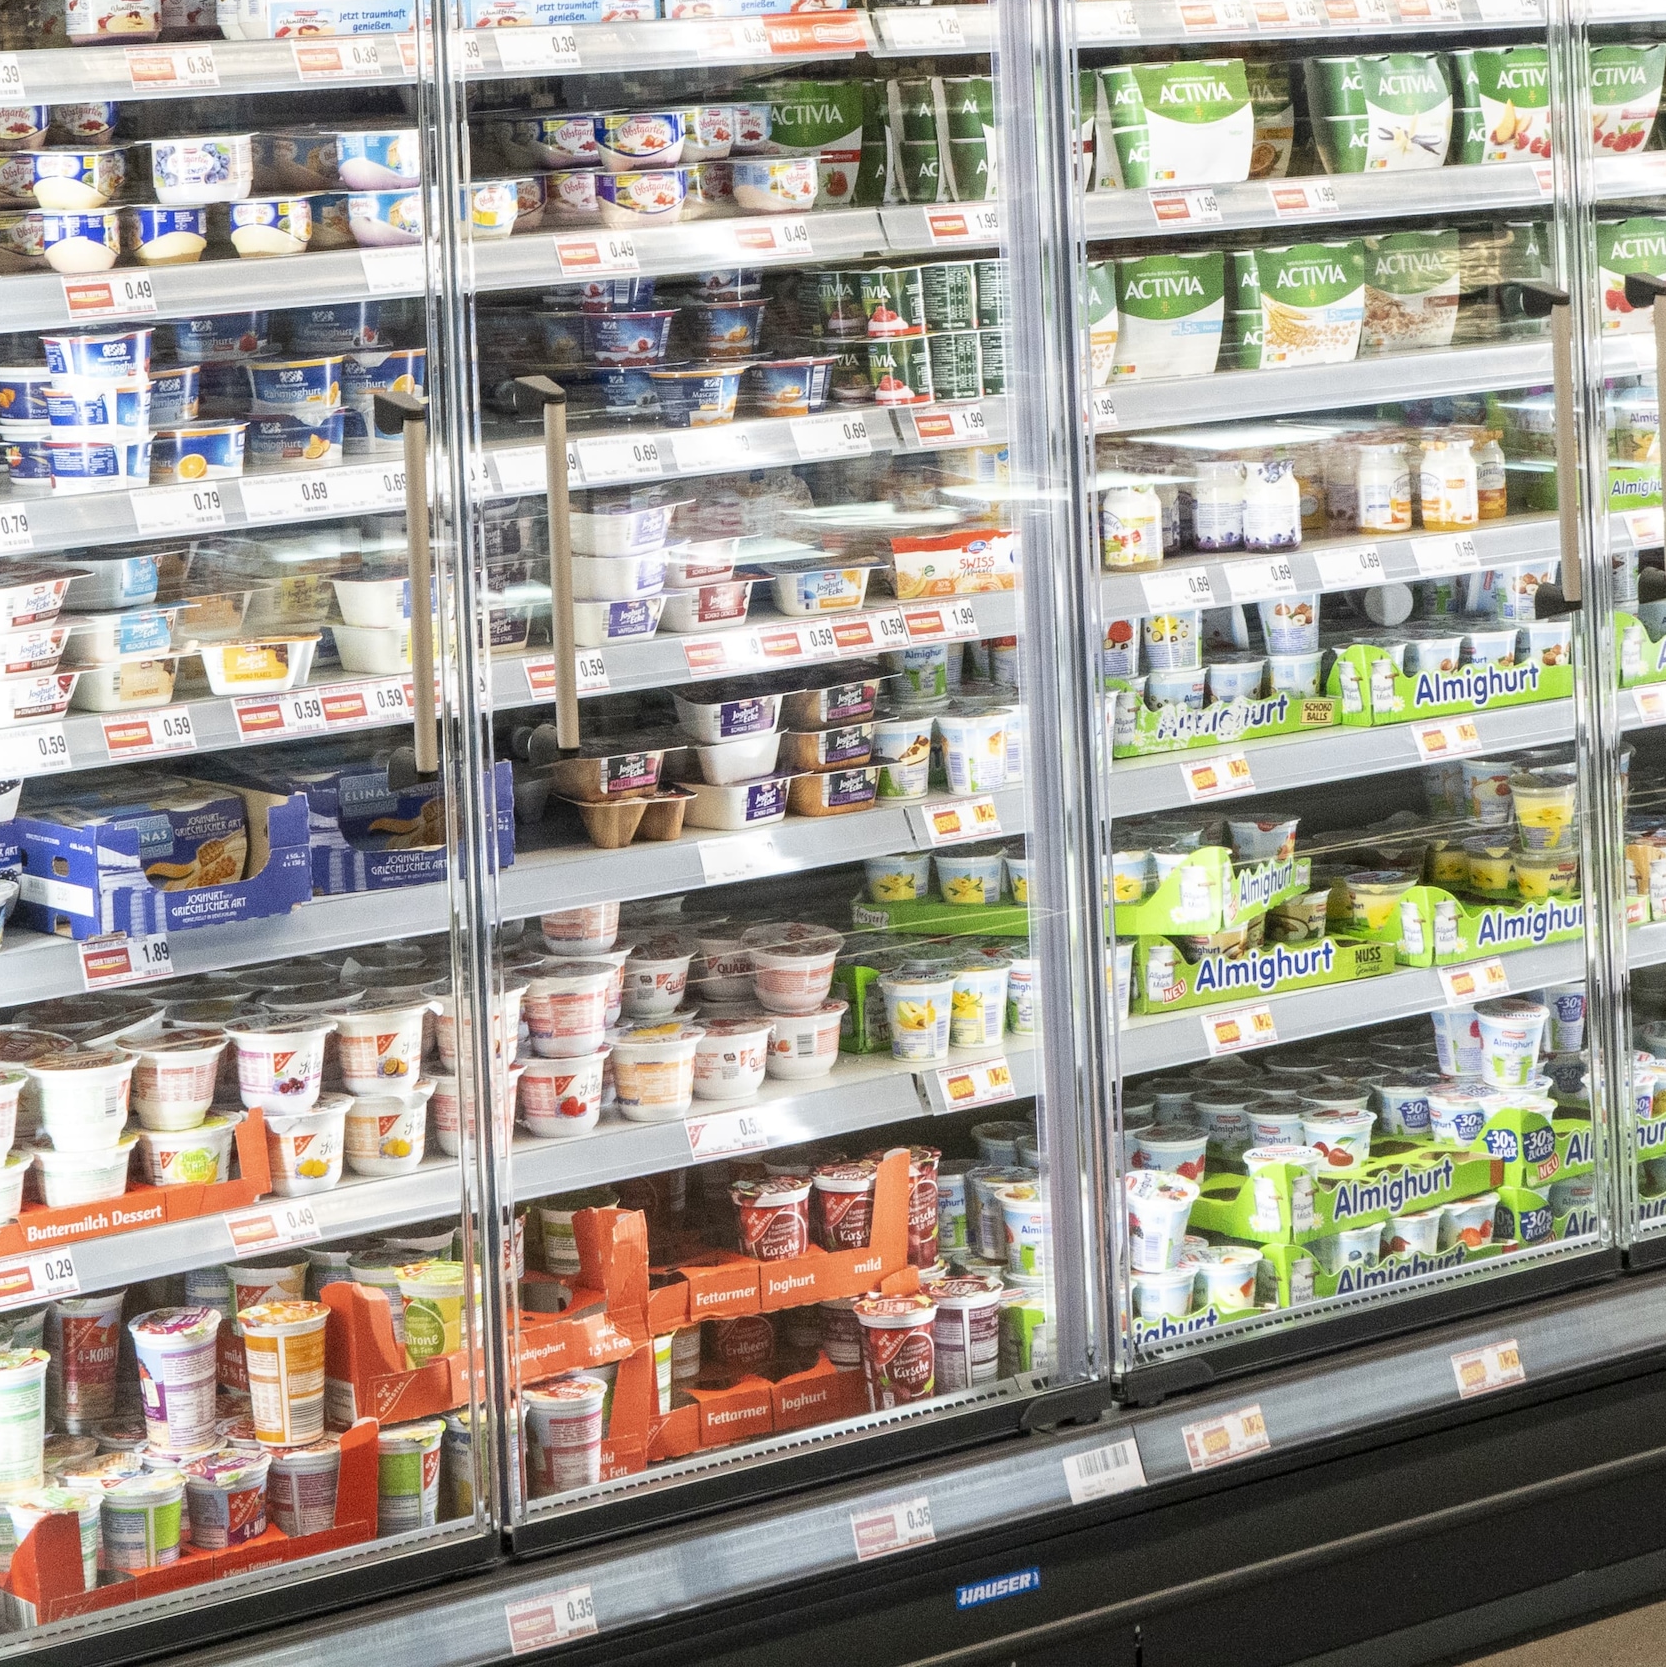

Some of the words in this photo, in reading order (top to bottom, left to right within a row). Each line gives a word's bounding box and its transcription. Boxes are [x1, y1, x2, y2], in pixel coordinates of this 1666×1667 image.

[339, 11, 361, 26] Jetzt
[363, 8, 407, 23] traumhaft
[536, 1, 557, 15] Jetzt
[352, 19, 394, 33] genießen.
[770, 24, 801, 44] NEU
[1158, 82, 1232, 103] ACTIVIA
[1377, 75, 1438, 95] ACTIVIA
[770, 101, 844, 126] ACTIVIA
[1124, 274, 1202, 301] ACTIVIA
[1276, 266, 1346, 288] ACTIVIA
[192, 490, 221, 511] 0.79
[301, 481, 327, 501] 0.69
[1415, 664, 1539, 708] Almighurt
[293, 700, 321, 720] 0.59
[1303, 701, 1333, 715] SCHOKO
[37, 735, 66, 757] 0.59
[1239, 859, 1293, 907] Almighurt
[186, 890, 223, 904] JOGHURT
[171, 901, 229, 917] GRIECHISCHER
[1195, 941, 1333, 994] Almighurt
[1354, 946, 1381, 963] NUSS
[1333, 1159, 1453, 1221] Almighurt
[26, 1211, 109, 1243] Buttermilch
[111, 1204, 162, 1225] Dessert
[45, 1257, 74, 1282] 0.29
[695, 1283, 757, 1307] Fettarmer
[768, 1271, 816, 1294] Joghurt
[853, 1257, 882, 1274] mild
[706, 1402, 769, 1426] Fettarmer
[781, 1388, 827, 1413] Joghurt
[906, 1507, 932, 1530] 0.35
[959, 1572, 1032, 1606] HAUSER
[567, 1596, 594, 1623] 0.35
